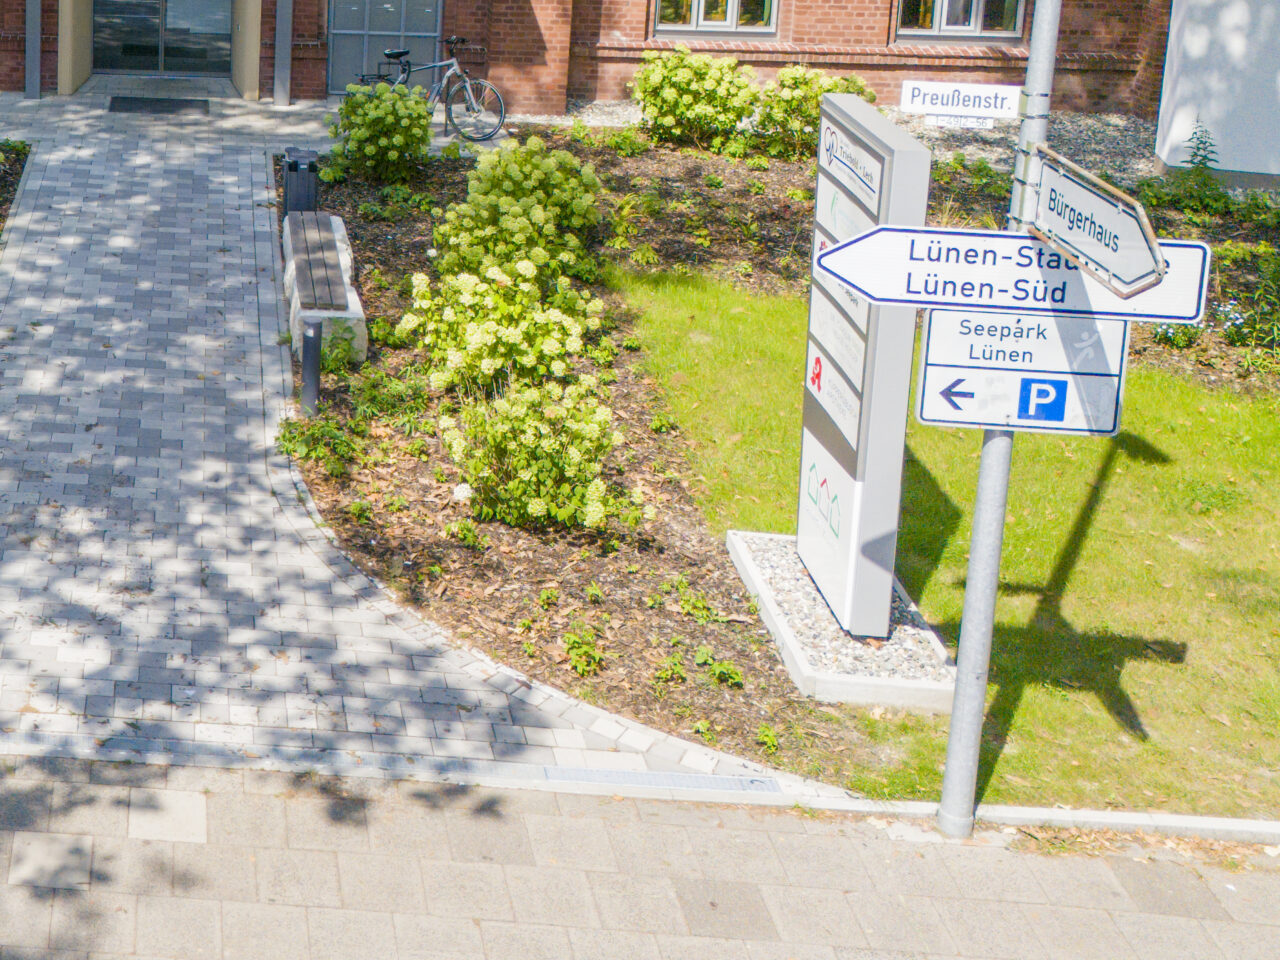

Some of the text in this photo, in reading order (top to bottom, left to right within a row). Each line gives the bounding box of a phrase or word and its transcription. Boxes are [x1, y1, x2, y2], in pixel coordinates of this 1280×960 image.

[911, 86, 1012, 111] Preußenstr.
[1048, 188, 1120, 253] Bürgerhaus
[905, 271, 1067, 304] Lünen-Süd
[959, 319, 1048, 341] Seepark
[968, 343, 1033, 364] Lünen
